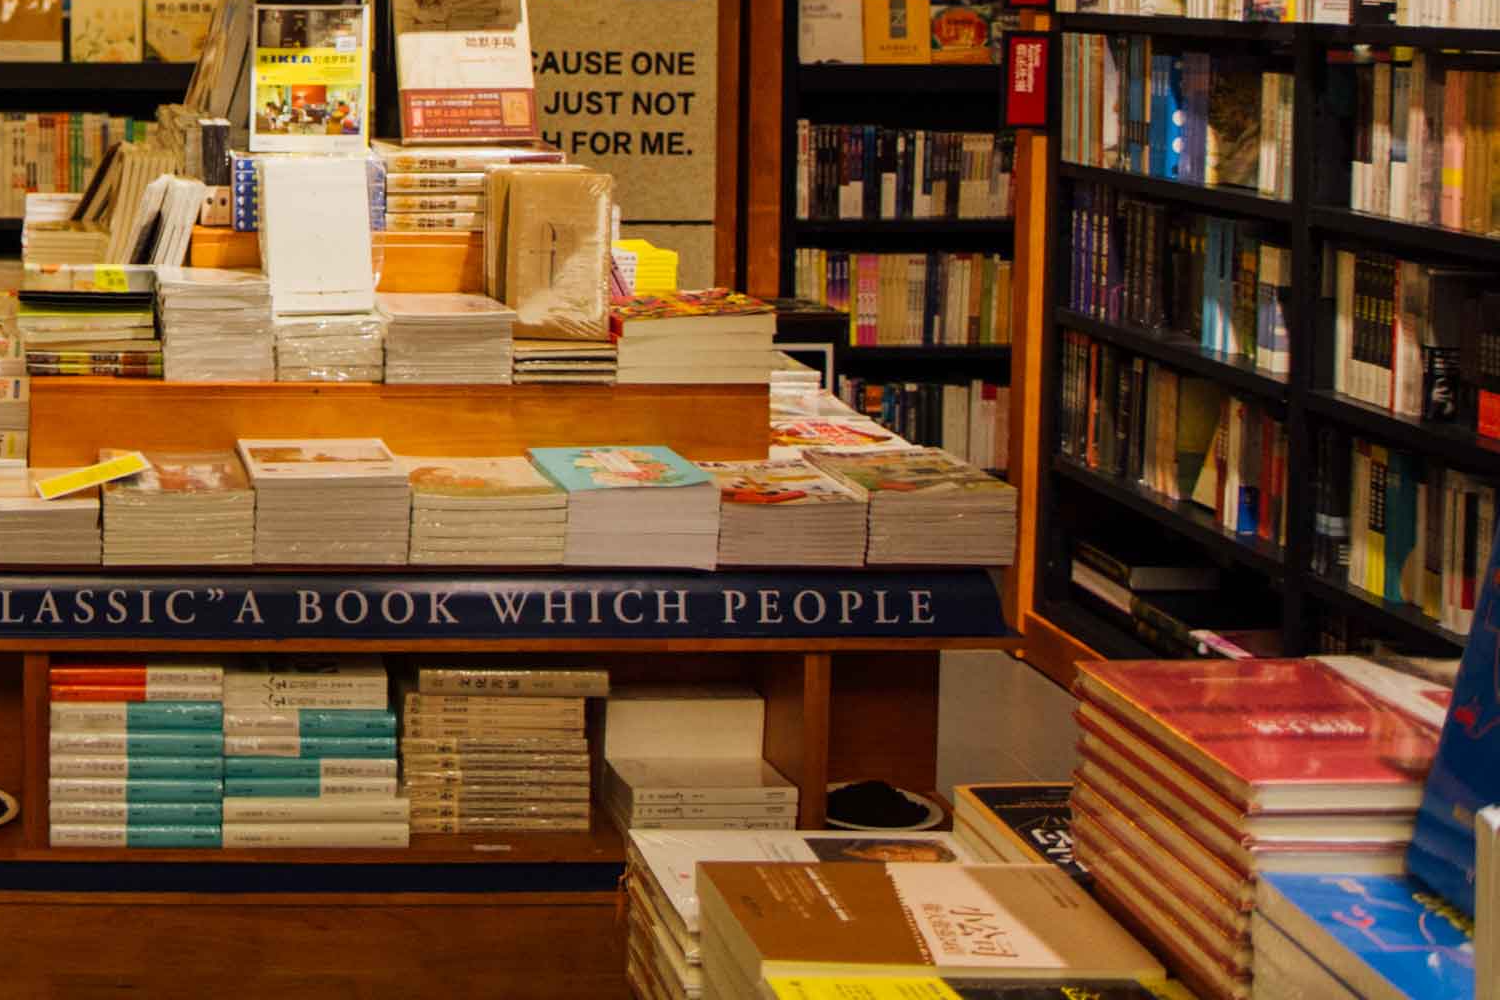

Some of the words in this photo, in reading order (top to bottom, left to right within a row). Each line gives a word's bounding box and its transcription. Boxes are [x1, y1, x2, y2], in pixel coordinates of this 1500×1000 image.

[631, 52, 696, 76] ONE
[545, 91, 626, 117] JUST
[631, 92, 696, 117] NOT
[572, 132, 632, 156] FOR
[640, 132, 694, 156] ME.
[296, 588, 461, 627] BOOK
[488, 587, 691, 626] WHICH
[720, 587, 937, 626] PEOPLE
